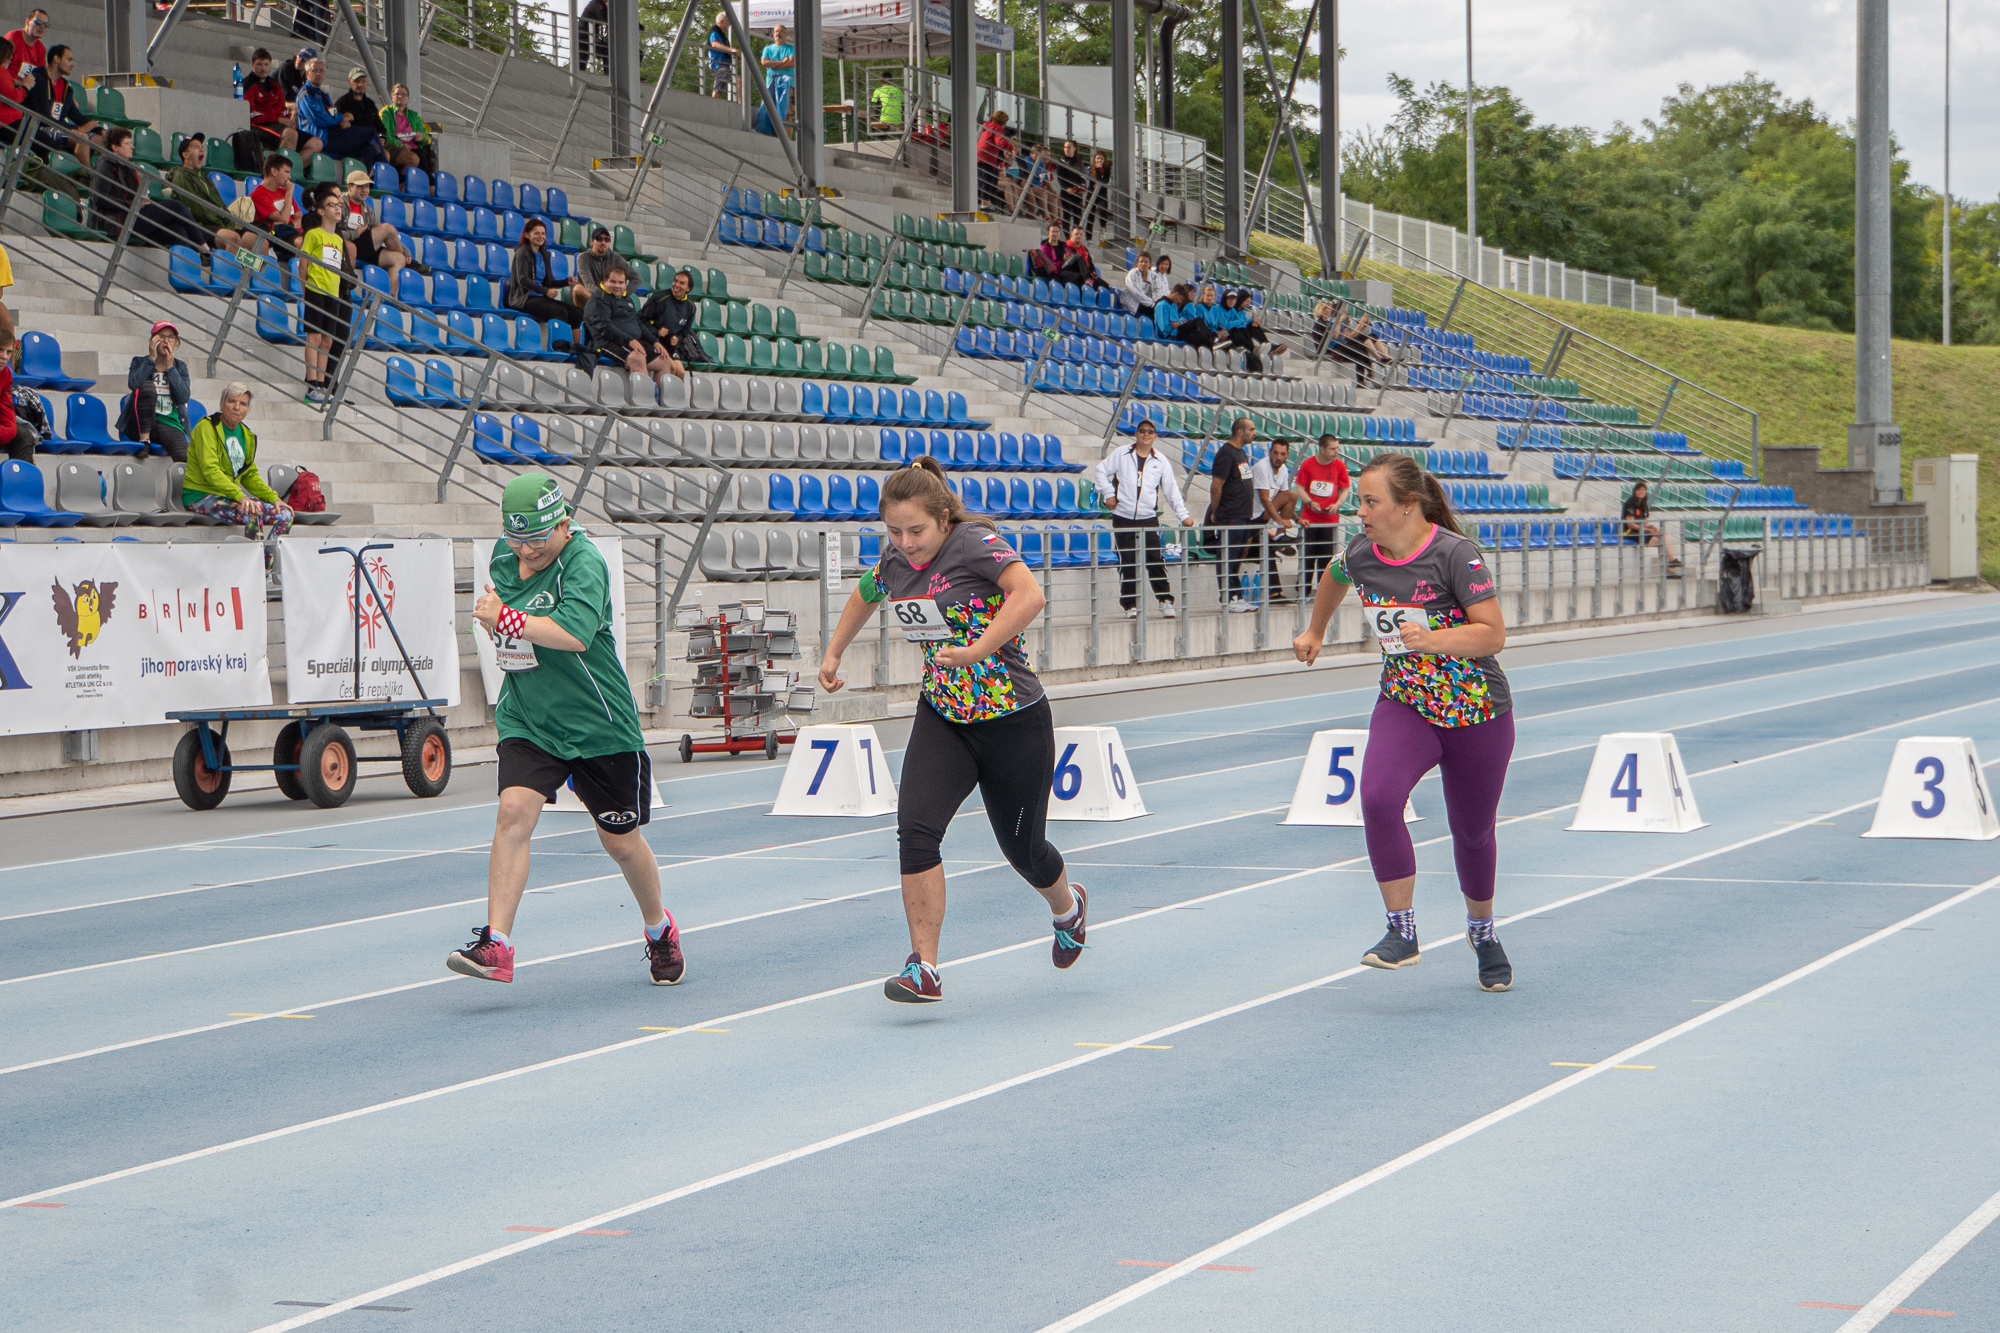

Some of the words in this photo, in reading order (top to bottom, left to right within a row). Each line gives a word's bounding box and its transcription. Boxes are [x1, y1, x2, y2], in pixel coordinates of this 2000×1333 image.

[332, 249, 338, 259] 2
[1316, 482, 1328, 491] 92
[894, 602, 928, 625] 68
[1411, 588, 1437, 602] down
[141, 654, 222, 678] jihomoravský
[225, 652, 247, 672] kraj
[806, 739, 840, 795] 7
[859, 738, 876, 795] 1
[1052, 743, 1083, 801] 6
[1108, 742, 1126, 800] 6
[1325, 746, 1356, 806] 5
[1610, 752, 1642, 813] 4
[1668, 752, 1686, 811] 4
[1911, 756, 1946, 819] 3
